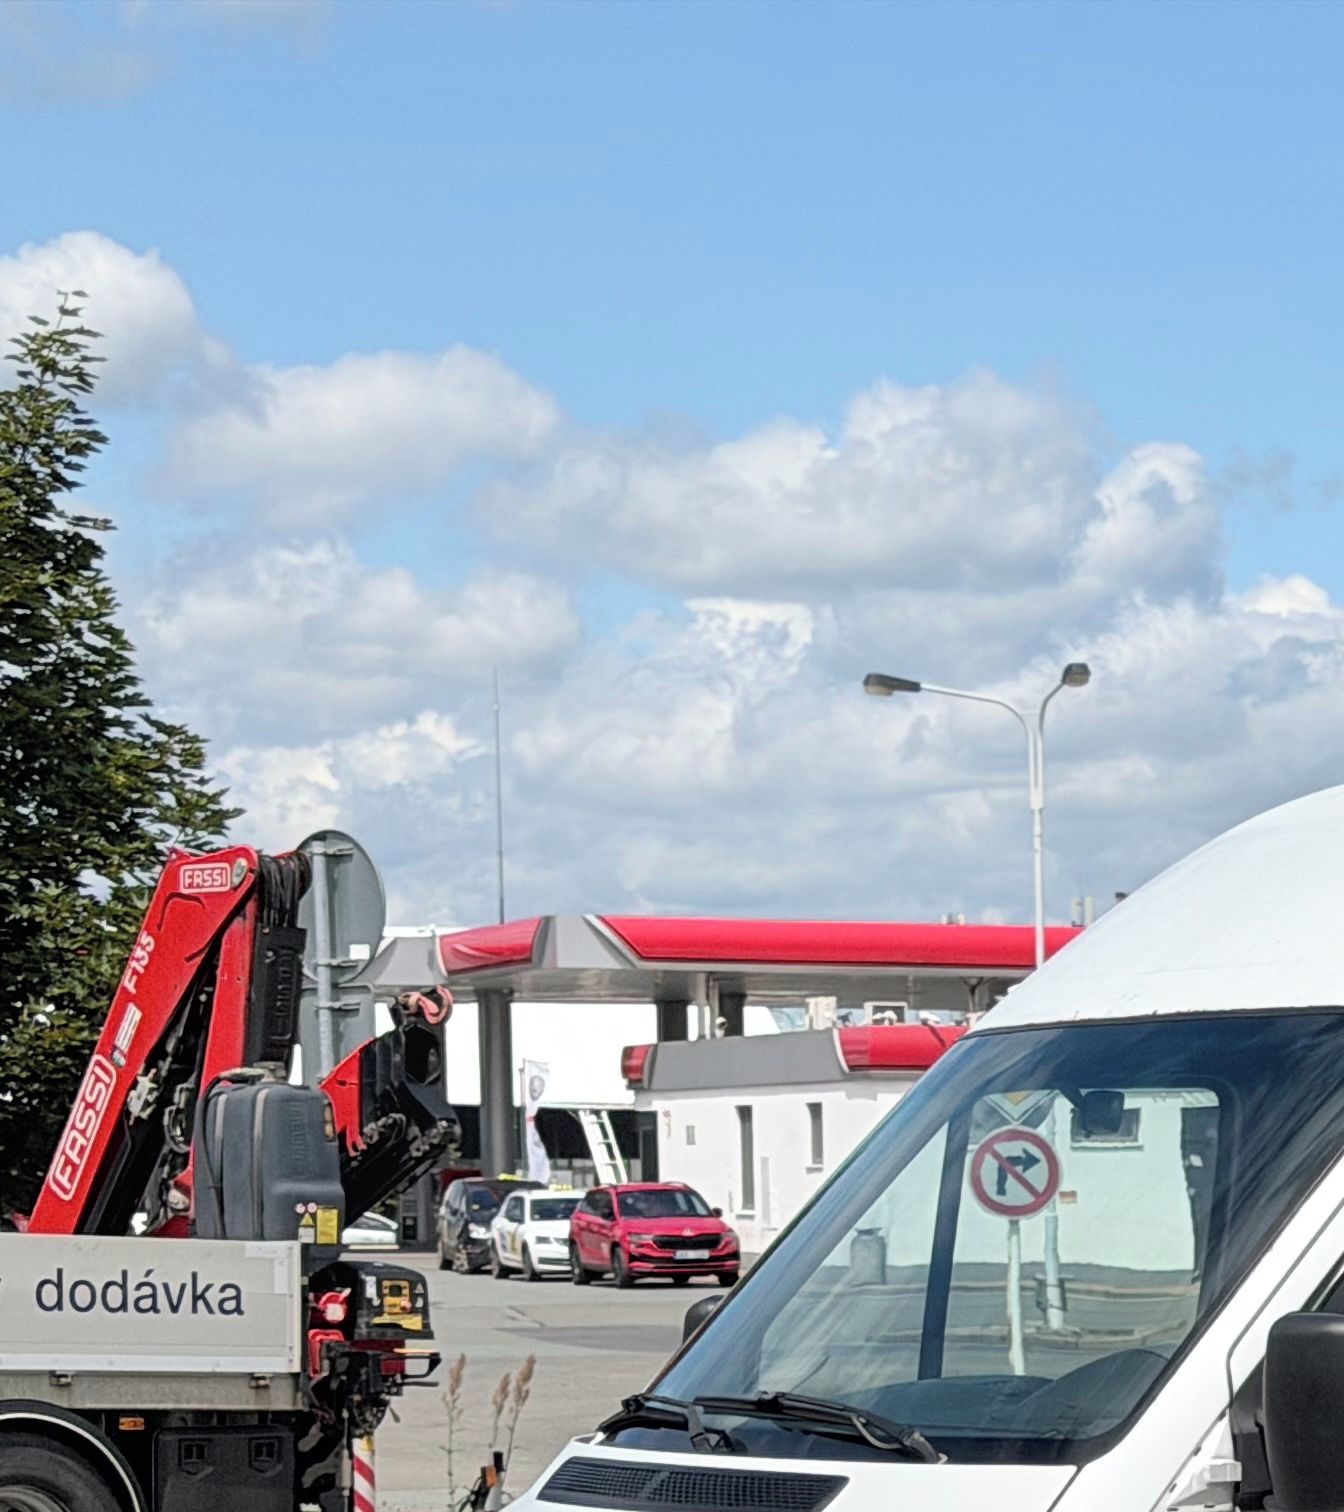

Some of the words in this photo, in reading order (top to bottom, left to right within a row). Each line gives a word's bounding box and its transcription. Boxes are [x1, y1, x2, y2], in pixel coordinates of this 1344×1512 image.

[183, 867, 227, 888] FASSI
[124, 930, 155, 994] F135
[54, 1063, 112, 1191] FASSI
[35, 1267, 245, 1316] dodávka
